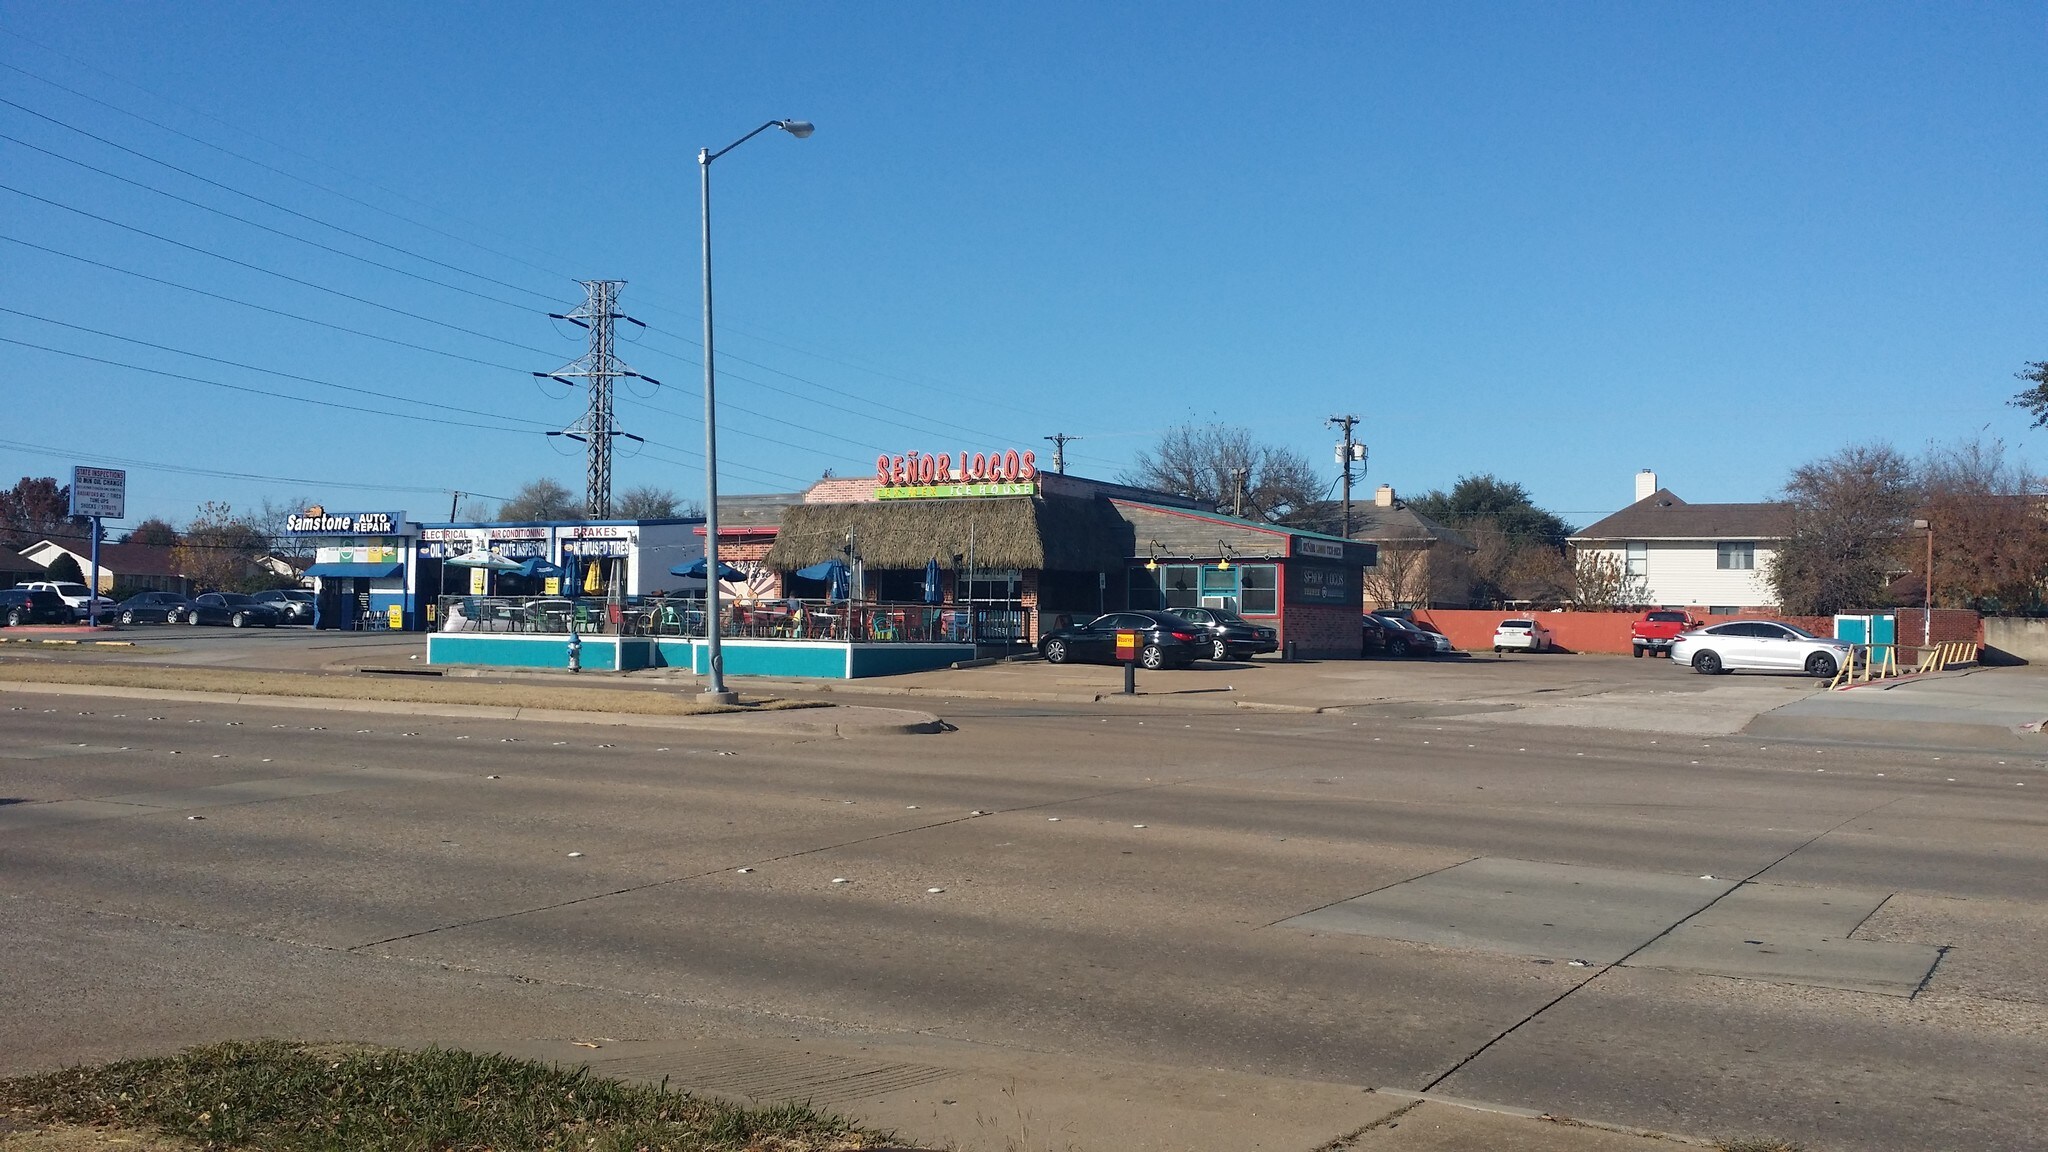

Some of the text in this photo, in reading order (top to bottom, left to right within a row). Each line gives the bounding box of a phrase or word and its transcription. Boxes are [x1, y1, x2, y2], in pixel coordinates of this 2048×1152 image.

[877, 449, 1035, 486] SEÑOR LOCOS
[91, 470, 123, 479] INSPECTIONS
[951, 485, 972, 495] ICE
[980, 483, 1031, 494] HOUSE
[286, 513, 350, 531] Samstone
[359, 513, 387, 523] AUTO
[353, 522, 390, 532] REPAIR
[573, 527, 617, 537] BRAKES
[421, 529, 468, 540] ELECTRICAL
[491, 528, 545, 539] AIR CONDITIONING
[430, 543, 442, 558] OIL
[499, 543, 516, 557] STATE
[609, 541, 629, 555] TIRES
